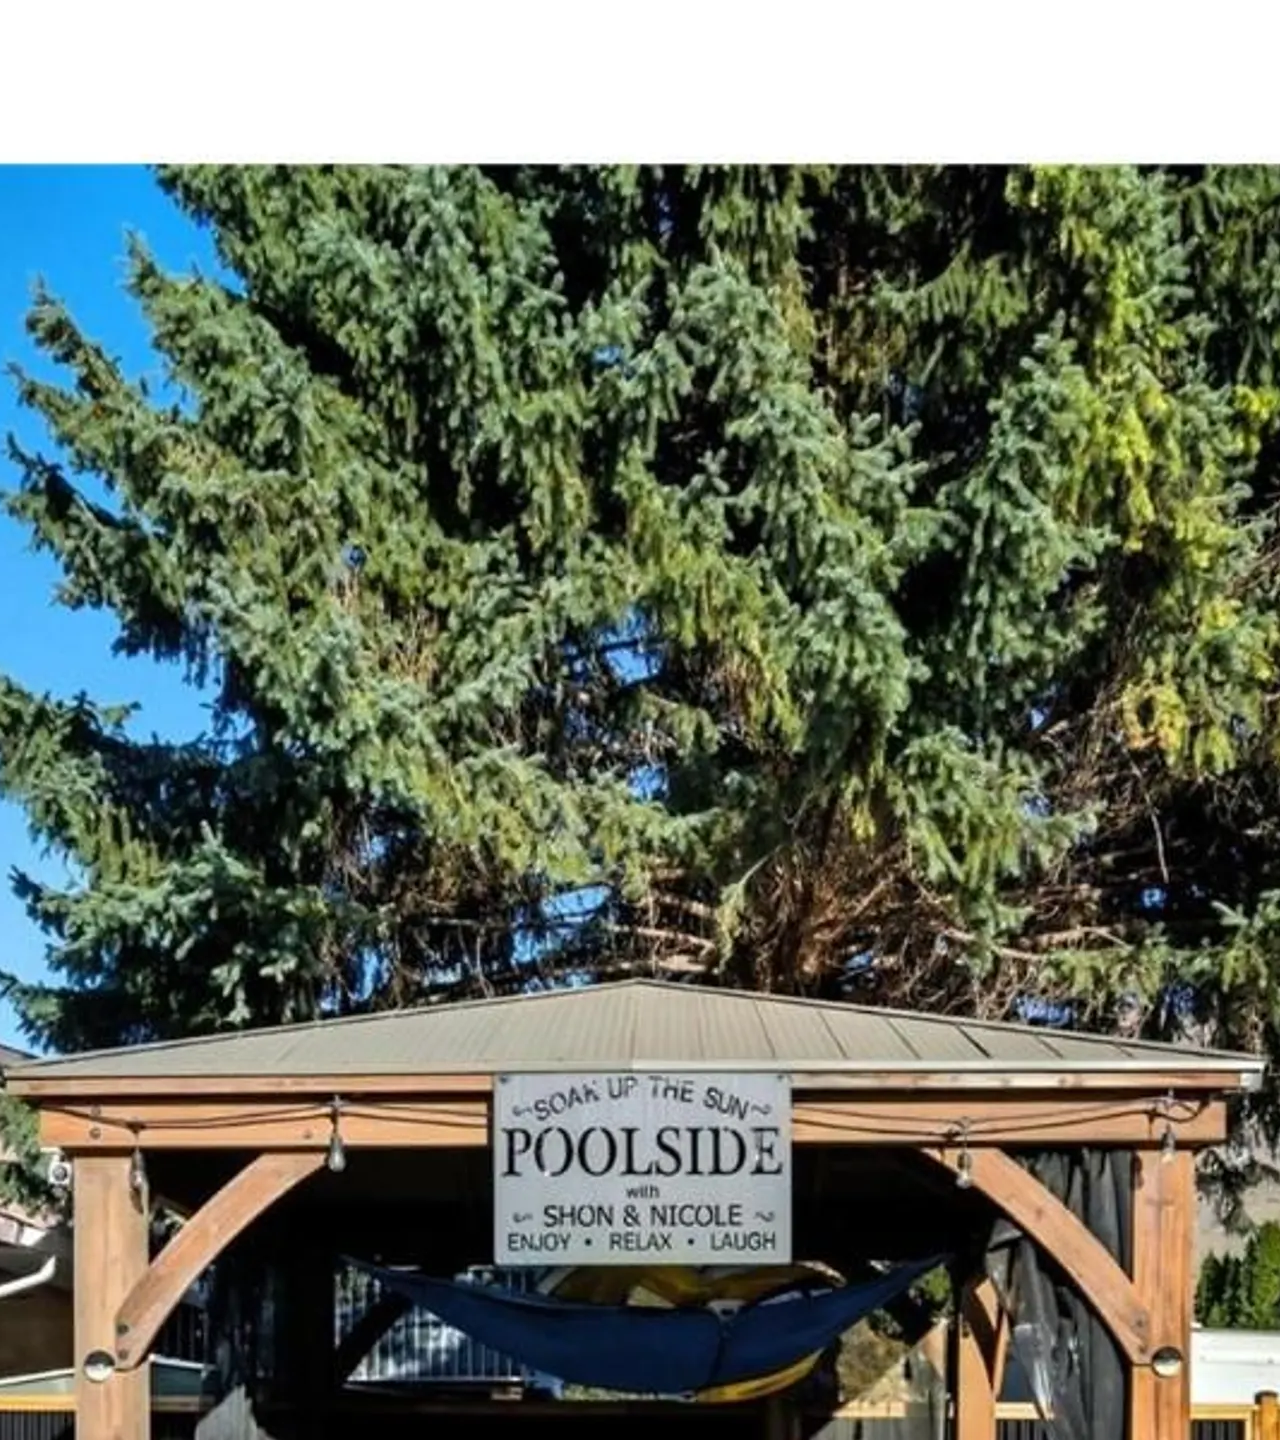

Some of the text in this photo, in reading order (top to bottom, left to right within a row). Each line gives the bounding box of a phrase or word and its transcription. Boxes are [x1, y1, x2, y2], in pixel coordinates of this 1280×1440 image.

[533, 1075, 750, 1122] SOAK UP THE SUN
[501, 1126, 783, 1178] POOLSIDE
[626, 1184, 660, 1199] with
[543, 1204, 743, 1228] SHON & NICOLE
[508, 1232, 776, 1251] ENJOY RELAX LAUGH
